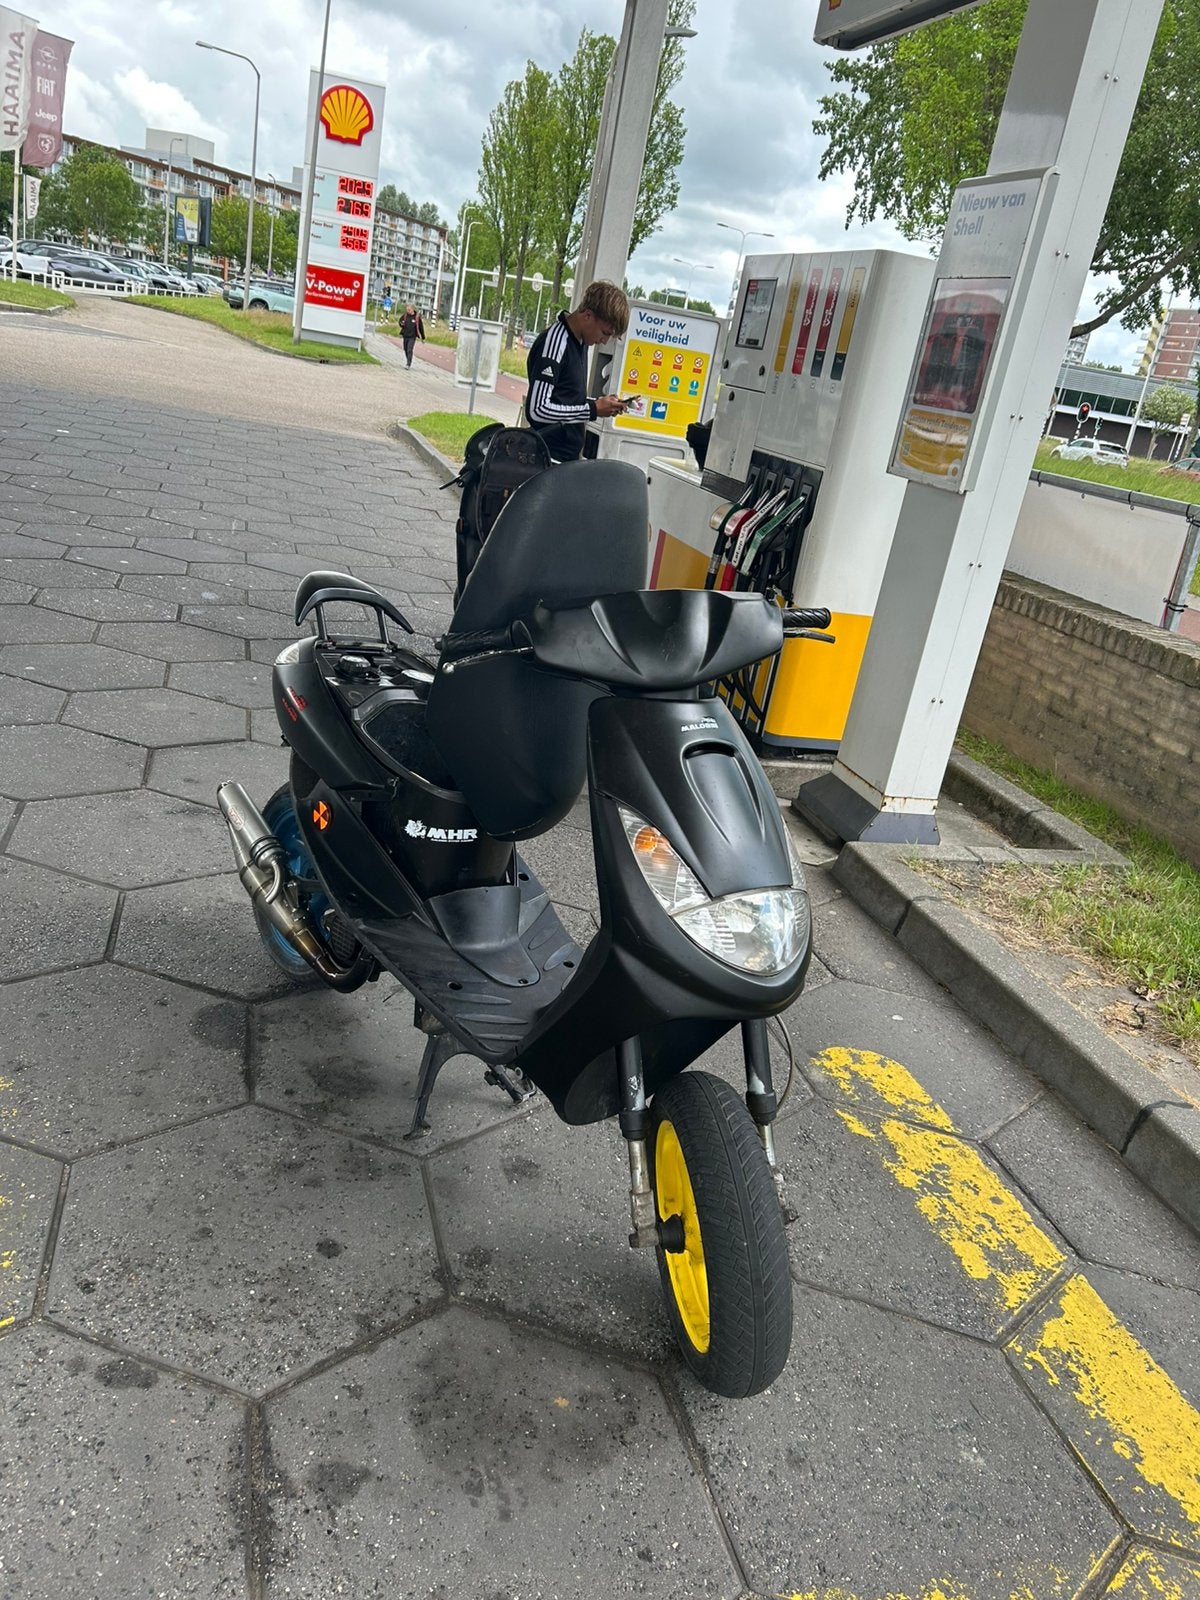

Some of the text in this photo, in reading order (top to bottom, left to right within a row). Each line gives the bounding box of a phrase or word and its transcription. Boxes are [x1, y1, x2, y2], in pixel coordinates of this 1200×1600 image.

[3, 31, 25, 137] HAAIMA
[36, 76, 56, 97] FIAT
[35, 108, 57, 122] Jeep
[959, 192, 1026, 212] Nieuw van
[953, 215, 984, 236] Shell
[305, 278, 358, 297] V-Power
[639, 311, 687, 330] Voor uw
[635, 328, 690, 346] veiligheid
[427, 827, 478, 839] MHR
